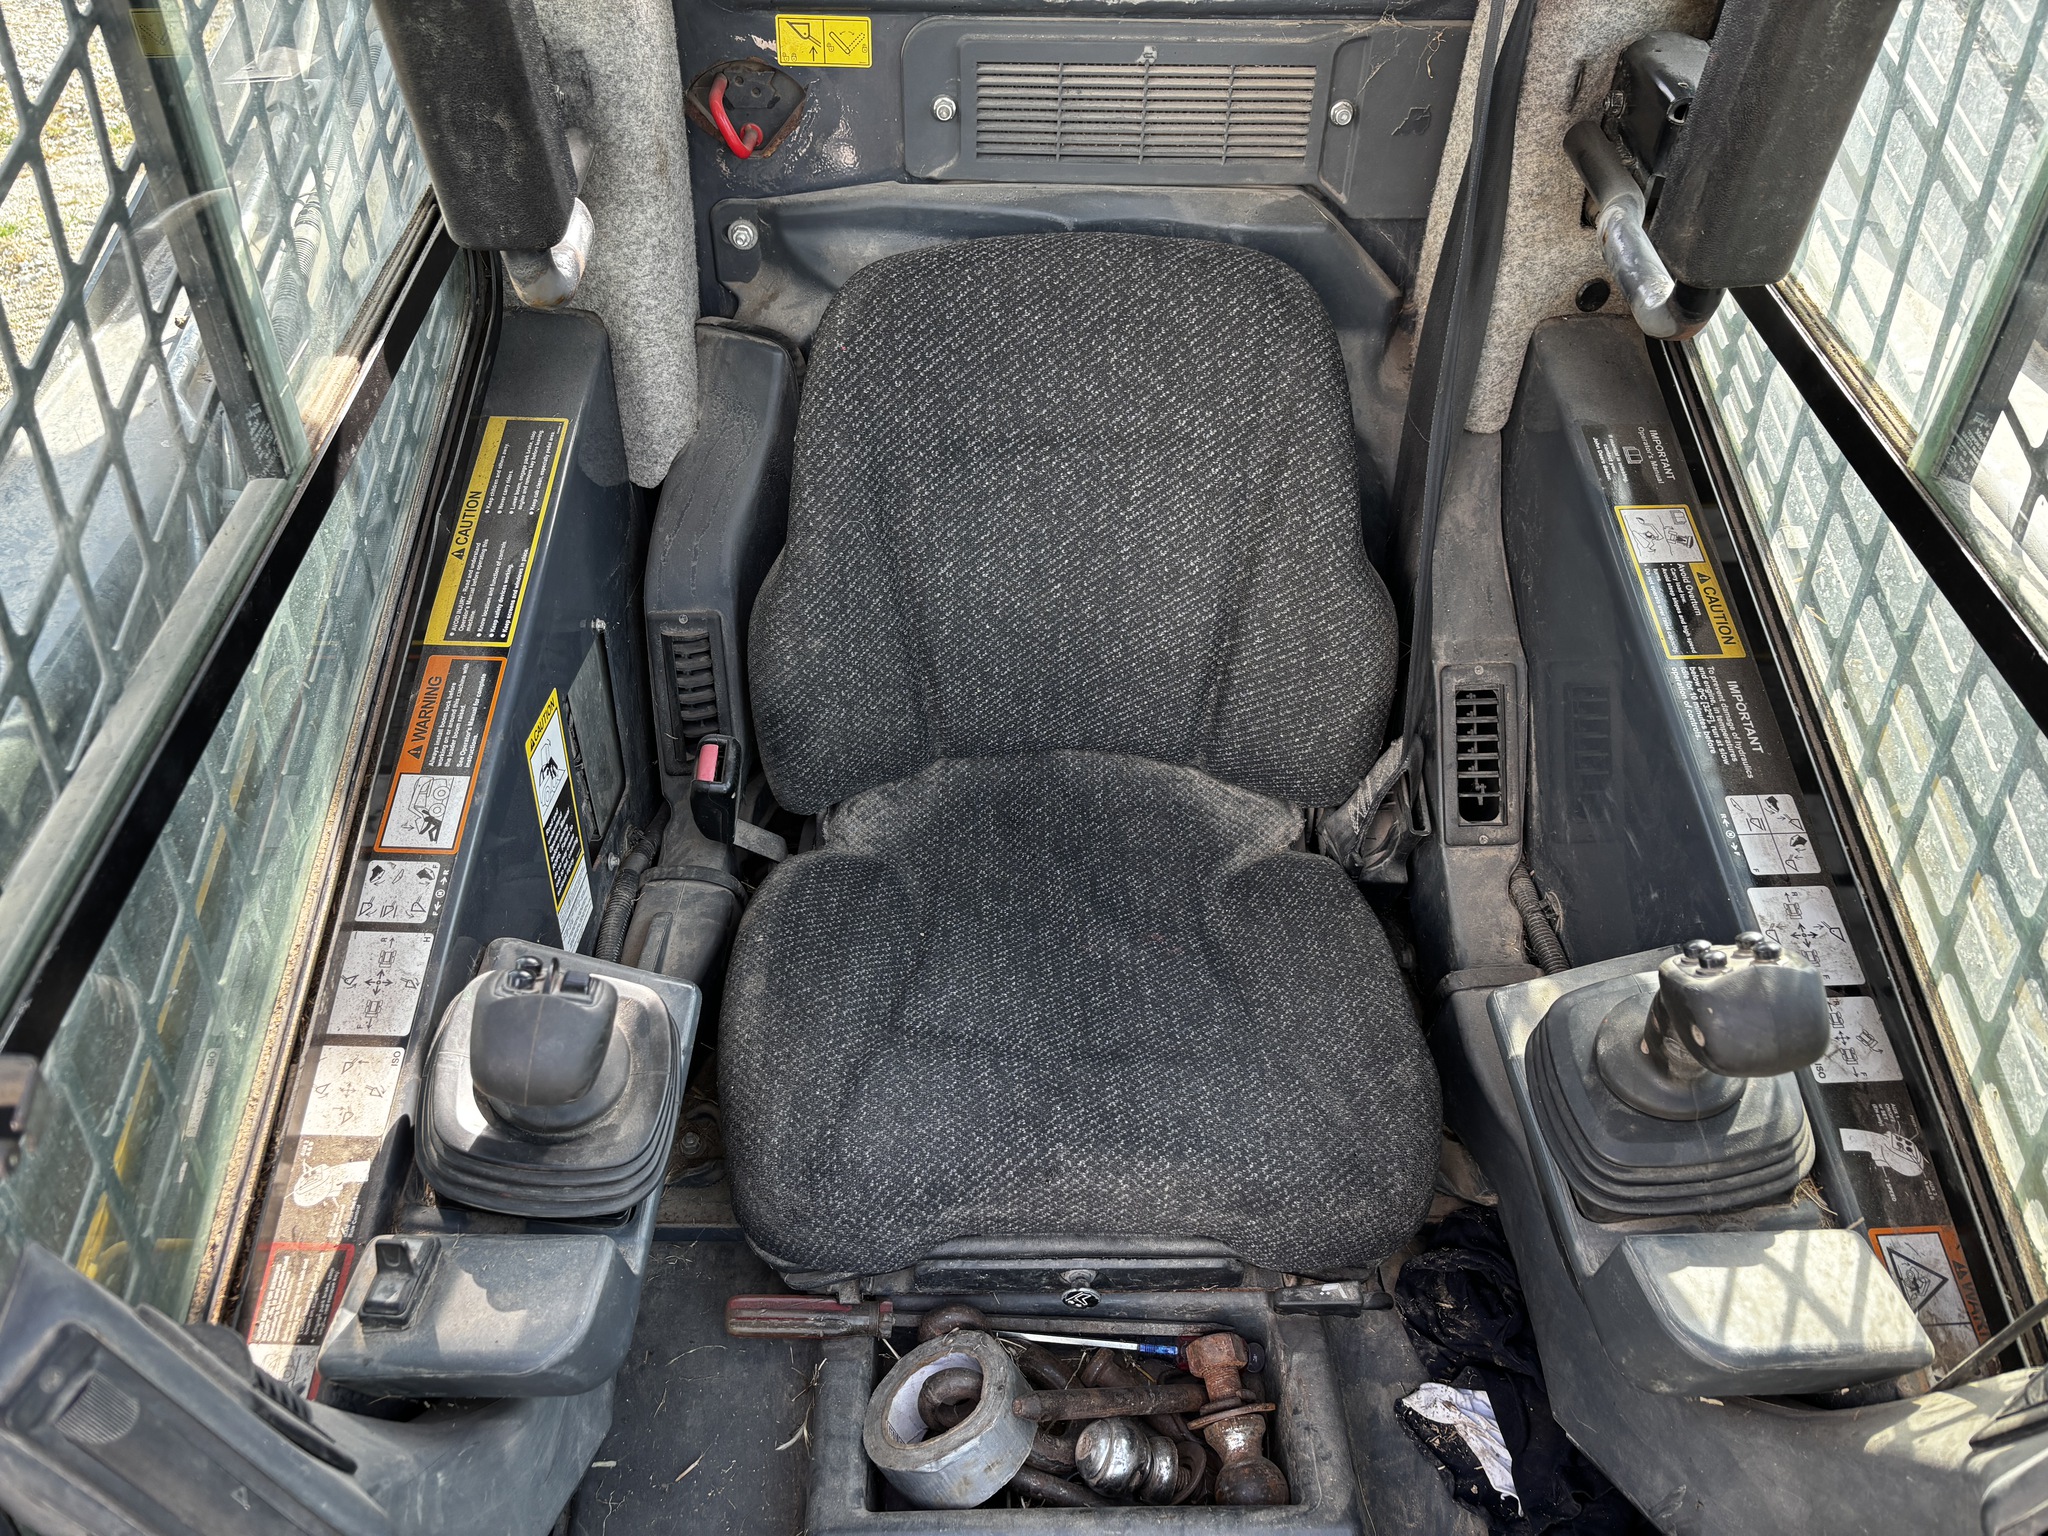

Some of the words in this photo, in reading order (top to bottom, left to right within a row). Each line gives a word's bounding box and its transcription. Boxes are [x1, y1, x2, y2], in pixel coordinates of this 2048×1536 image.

[529, 430, 537, 439] stop
[534, 429, 544, 445] leaving.
[502, 442, 511, 454] away.
[525, 440, 534, 453] brake,
[530, 446, 538, 459] before
[544, 442, 552, 453] pedal
[1609, 438, 1619, 456] manual
[1635, 426, 1655, 458] Operator's
[1649, 460, 1664, 483] Manual
[1648, 429, 1675, 480] IMPORTANT
[496, 455, 505, 468] others
[522, 455, 530, 463] park
[528, 460, 536, 468] key
[539, 454, 550, 475] especially
[1592, 437, 1600, 449] John
[1596, 450, 1606, 463] Deere
[1602, 465, 1612, 480] dealer.
[1602, 443, 1613, 461] contact
[1608, 462, 1618, 473] your
[505, 469, 513, 483] riders.
[518, 465, 528, 480] engage
[523, 469, 532, 484] remove
[489, 478, 499, 496] children
[502, 484, 510, 495] carry
[514, 481, 523, 494] boom,
[535, 476, 544, 488] clean,
[485, 497, 494, 508] Keep
[498, 496, 506, 508] Never
[510, 496, 518, 509] Lower
[517, 494, 527, 509] engine
[530, 499, 538, 510] Keep
[454, 490, 482, 545] CAUTION
[468, 542, 481, 568] understand
[497, 540, 507, 560] controls.
[520, 547, 530, 561] place.
[466, 569, 474, 578] and
[490, 566, 500, 585] function
[502, 563, 514, 583] working.
[513, 568, 523, 588] windows
[1646, 576, 1654, 584] not
[1661, 568, 1671, 581] Avoid
[1668, 567, 1679, 580] Carry
[1675, 582, 1683, 592] load
[458, 606, 471, 630] Operator's
[465, 587, 475, 604] Manual
[470, 571, 480, 585] before
[475, 548, 487, 570] operating
[481, 538, 489, 547] this
[462, 580, 471, 591] Read
[1665, 582, 1676, 596] steep
[1676, 563, 1690, 582] Avoid
[1684, 584, 1702, 615] Overturn
[497, 584, 507, 602] devices
[1648, 585, 1661, 604] operate
[456, 595, 466, 614] INJURY
[481, 597, 492, 616] location
[493, 603, 503, 618] safety
[505, 600, 515, 618] screens
[1656, 605, 1666, 615] over
[1670, 597, 1682, 613] slopes
[451, 615, 461, 630] AVOID
[465, 609, 476, 630] machine.
[1677, 614, 1686, 624] and
[1702, 586, 1736, 644] CAUTION
[477, 617, 486, 631] Know
[490, 619, 499, 631] Keep
[502, 620, 511, 632] Keep
[1660, 617, 1671, 630] rated
[1680, 625, 1690, 636] high
[1684, 638, 1696, 653] speed
[461, 662, 469, 673] with
[1697, 666, 1707, 679] and
[1706, 666, 1716, 674] To
[445, 682, 456, 698] before
[455, 674, 466, 696] machine
[475, 673, 488, 696] complete
[1684, 680, 1694, 690] for
[1701, 680, 1717, 705] engine,
[1708, 676, 1726, 701] prevent
[452, 698, 460, 707] this
[1669, 666, 1688, 699] operation
[1686, 709, 1702, 740] controls.
[1689, 692, 1698, 700] 10
[410, 675, 443, 742] WARNING
[442, 700, 451, 711] lock
[456, 704, 466, 721] raised.
[438, 712, 448, 727] boom
[446, 709, 457, 727] around
[467, 706, 478, 726] Manual
[533, 696, 554, 742] CAUTION
[1688, 666, 1702, 686] below
[1710, 725, 1720, 737] run
[1718, 748, 1730, 764] slow
[1692, 701, 1708, 729] minutes
[1719, 703, 1736, 730] damage
[1726, 680, 1764, 753] IMPORTANT
[433, 728, 444, 745] install
[452, 722, 461, 738] boom
[459, 727, 473, 755] Operator's
[1702, 730, 1716, 753] before
[1714, 715, 1737, 762] temperatures
[436, 744, 448, 766] working
[447, 739, 456, 756] loader
[428, 746, 440, 766] Always
[444, 758, 452, 766] the
[456, 756, 464, 766] See
[1733, 741, 1754, 778] hydraulics
[391, 1051, 400, 1066] ISO
[1815, 1062, 1826, 1079] ISO
